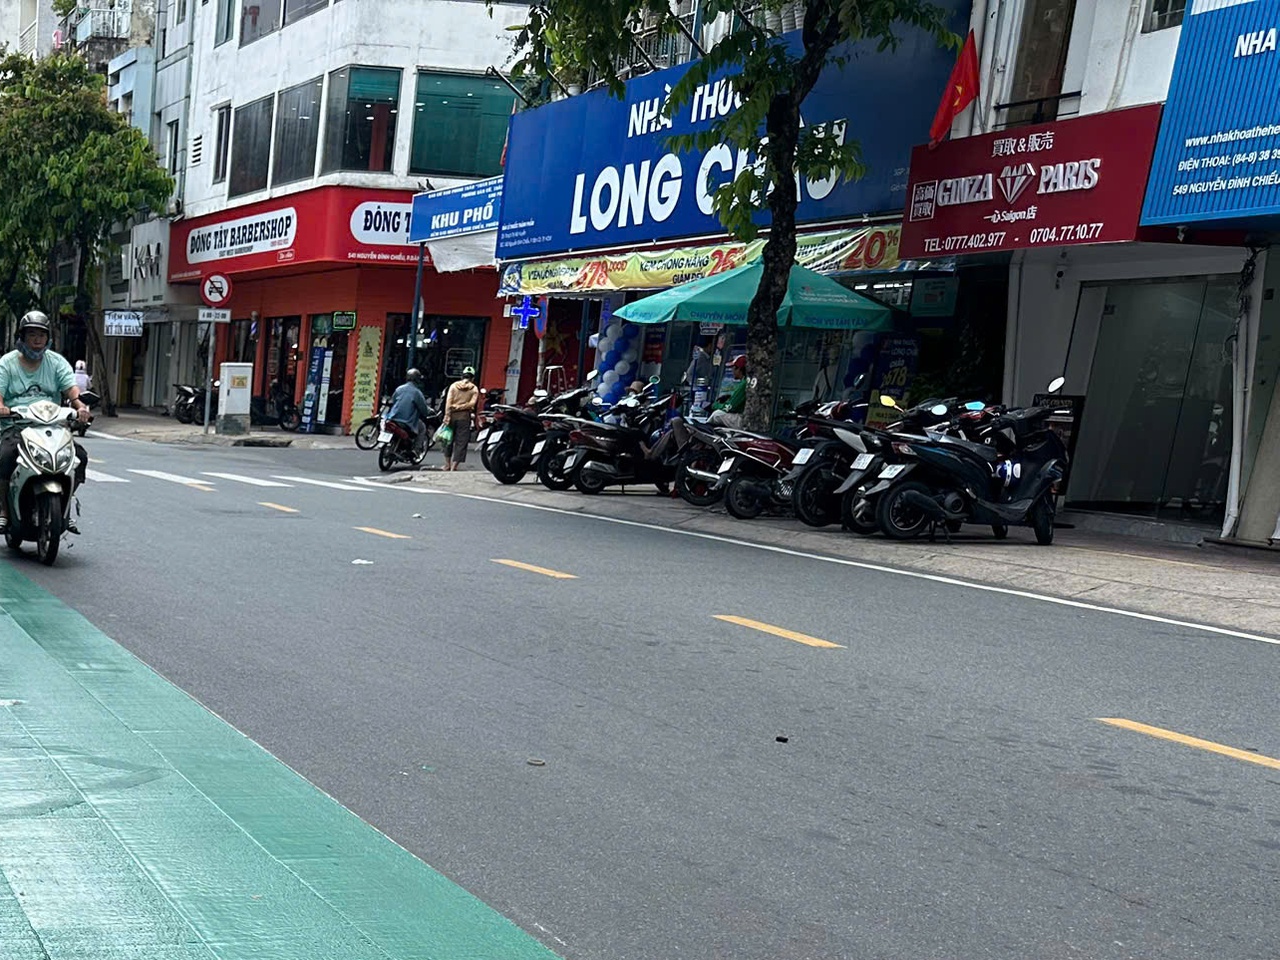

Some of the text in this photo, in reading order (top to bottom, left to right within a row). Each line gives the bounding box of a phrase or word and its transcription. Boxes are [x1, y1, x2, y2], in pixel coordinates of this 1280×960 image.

[1234, 27, 1276, 58] NHA
[1178, 157, 1200, 172] ĐIỆN
[1201, 155, 1231, 169] THOẠI:
[1232, 151, 1257, 167] (84-8)
[1258, 150, 1270, 161] 38
[570, 153, 683, 235] LONG
[937, 158, 1102, 206] GINZA PARIS
[1172, 184, 1189, 196] 549
[1189, 176, 1227, 194] NGUYỄN
[1227, 176, 1251, 189] ĐÌNH
[363, 206, 401, 233] ĐÔNG
[431, 210, 459, 230] KHU
[463, 198, 495, 224] PHỐ
[190, 215, 293, 255] ĐÔNG TÂY BARBERSHOP
[1030, 223, 1104, 243] 0704.77.10.77
